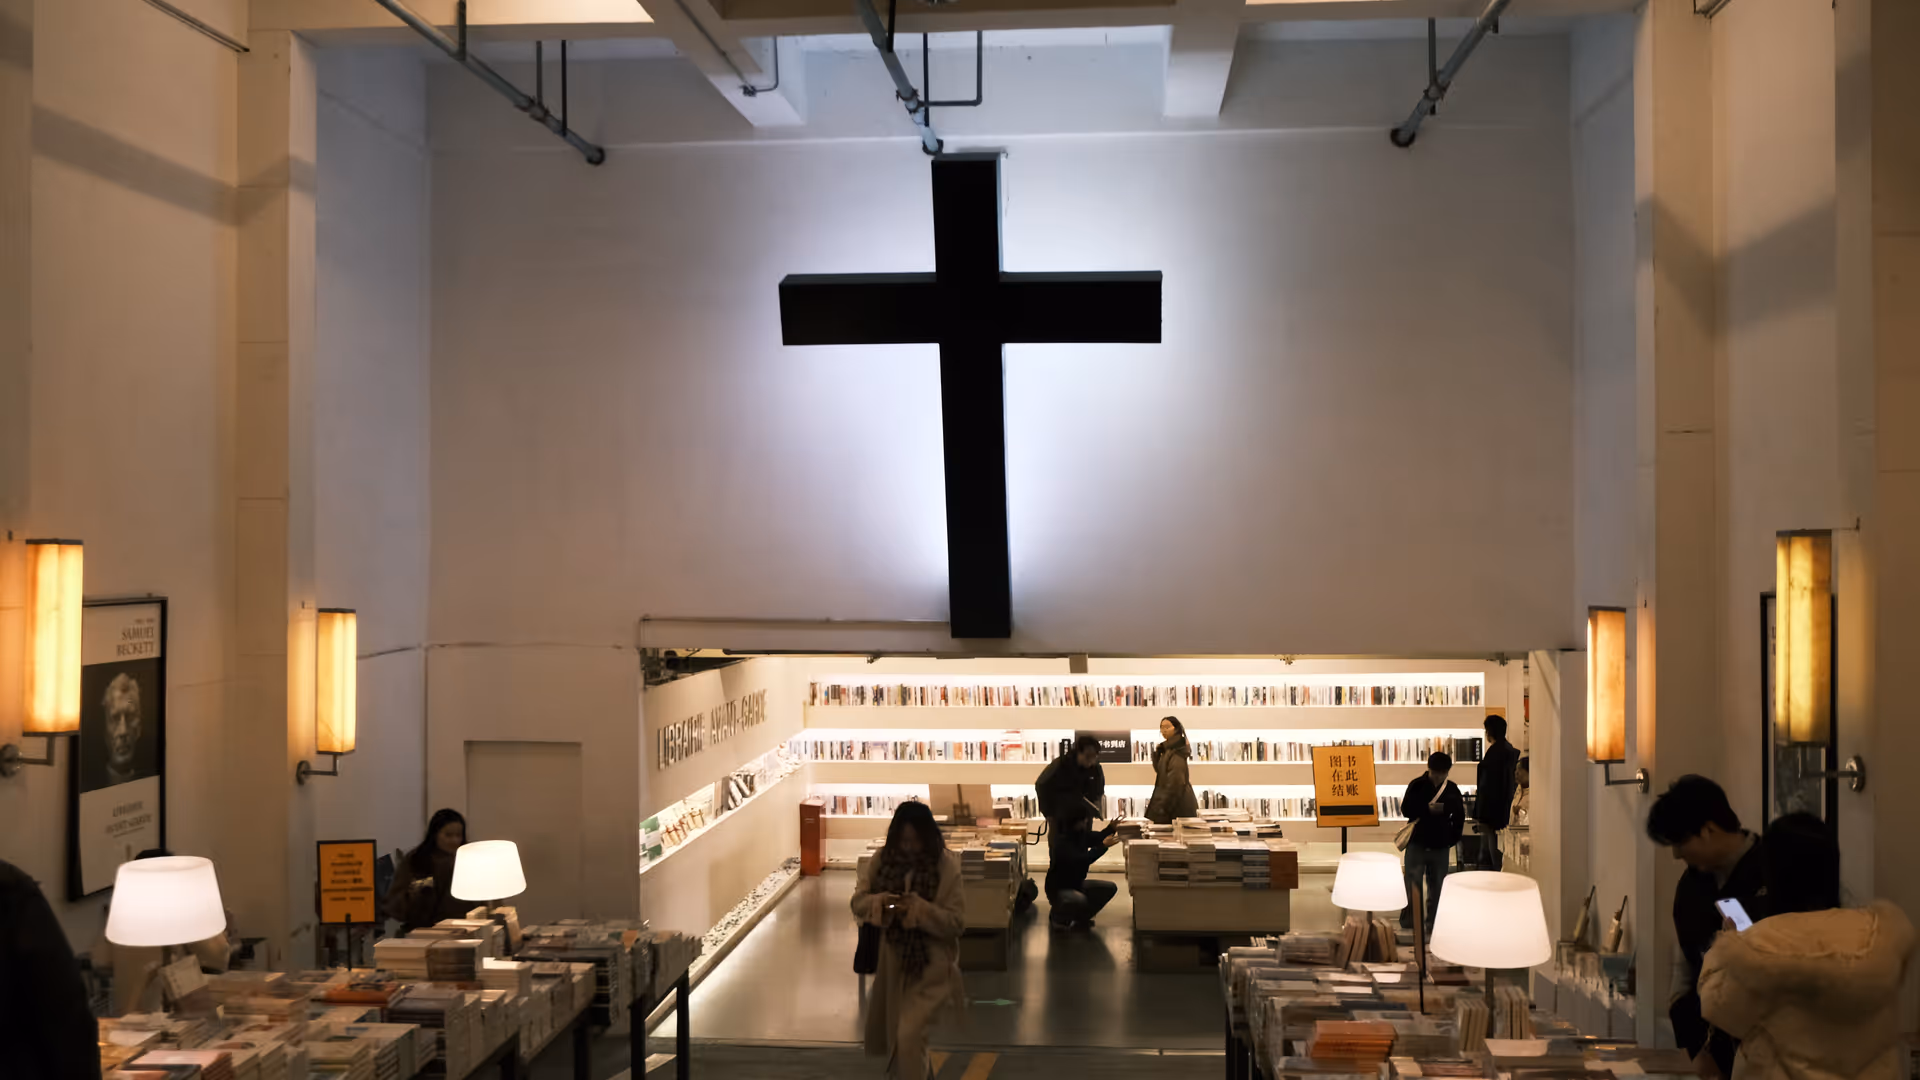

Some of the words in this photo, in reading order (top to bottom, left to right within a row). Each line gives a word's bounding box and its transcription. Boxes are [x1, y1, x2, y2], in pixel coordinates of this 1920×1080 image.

[121, 626, 154, 641] SAMUEL
[116, 641, 154, 657] BECKETT
[657, 712, 706, 772] LIBRAIRIE
[710, 688, 768, 746] AVANT-GARDE
[1329, 754, 1356, 768] 图书
[1331, 769, 1358, 782] 在此
[1331, 784, 1359, 797] 结账
